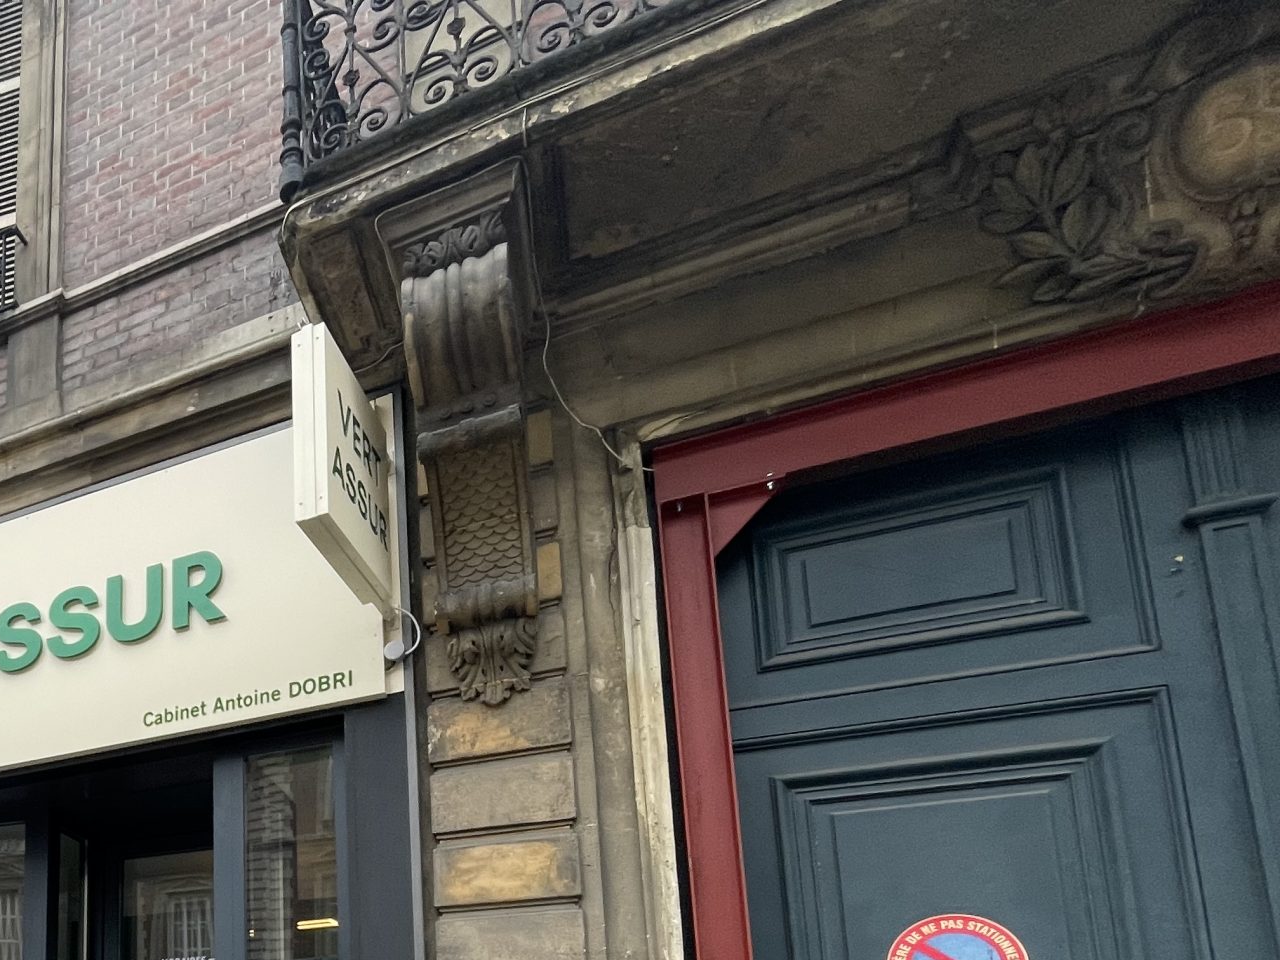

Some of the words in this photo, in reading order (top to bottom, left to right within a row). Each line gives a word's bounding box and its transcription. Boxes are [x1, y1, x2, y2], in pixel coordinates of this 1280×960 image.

[337, 388, 381, 487] VERT
[332, 446, 388, 552] ASSUR
[143, 701, 207, 727] Cabinet
[213, 689, 281, 714] Antoine
[288, 670, 353, 698] DOBRI
[906, 931, 923, 946] DE
[920, 922, 937, 937] NE
[940, 919, 964, 930] PAS
